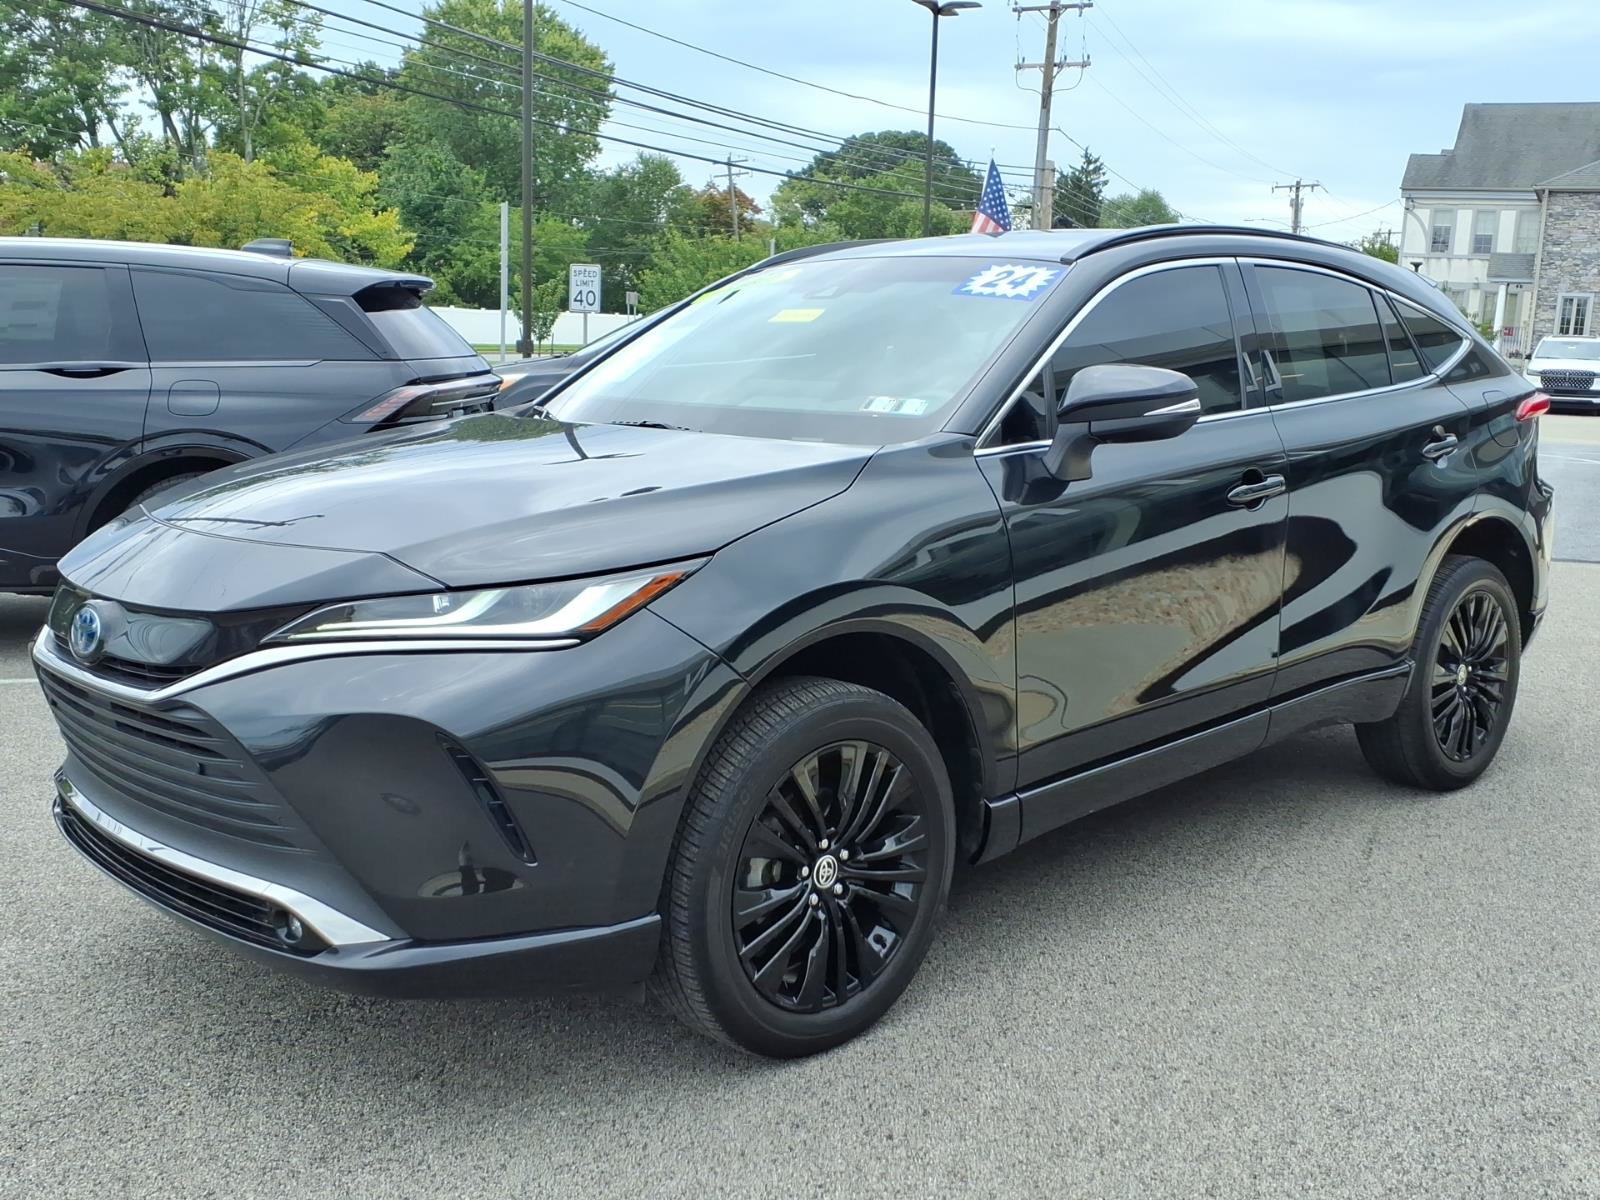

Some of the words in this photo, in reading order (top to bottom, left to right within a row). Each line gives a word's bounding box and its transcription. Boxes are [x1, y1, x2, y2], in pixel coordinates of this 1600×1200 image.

[573, 269, 598, 278] SPEED
[979, 270, 1038, 290] 24
[575, 279, 595, 287] LIMIT
[573, 289, 596, 307] 40
